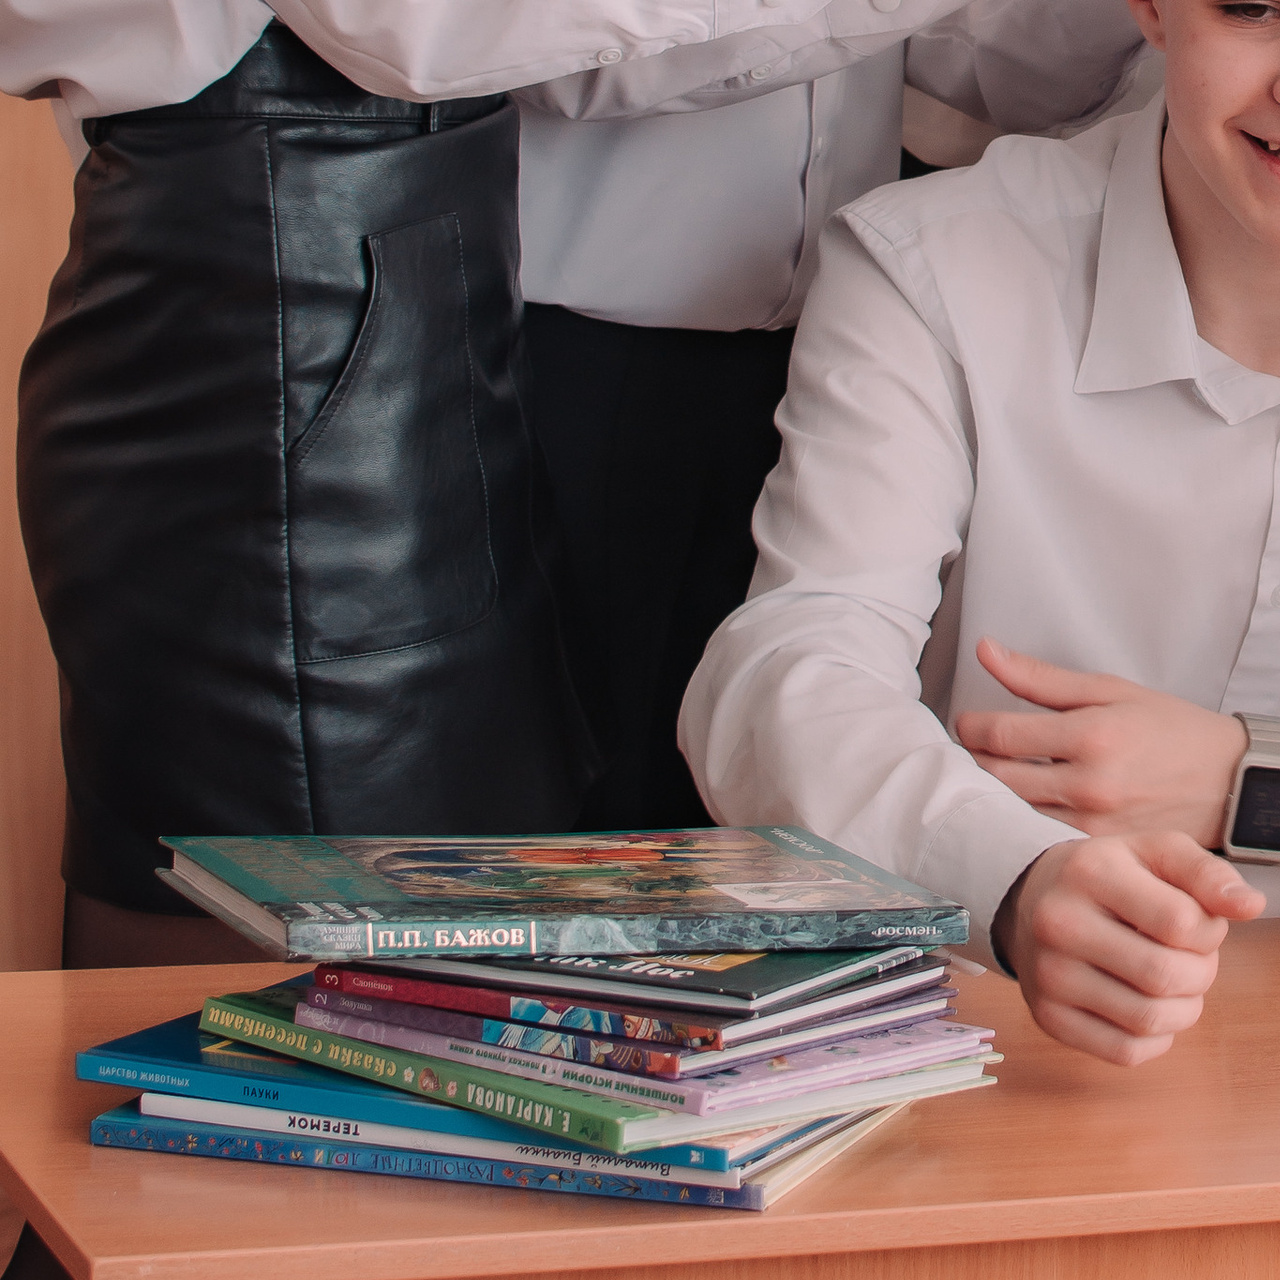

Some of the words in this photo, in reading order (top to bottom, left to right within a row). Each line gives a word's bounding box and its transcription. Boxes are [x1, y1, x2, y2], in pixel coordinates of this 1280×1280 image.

[322, 926, 361, 934] ЛУЧШИЕ
[323, 934, 361, 942] СКАЗКИ
[377, 929, 428, 949] П.П.
[434, 927, 526, 948] БАЖОВ
[871, 926, 943, 937] «РОСМЭН»
[335, 942, 362, 951] МИРА
[325, 974, 339, 986] 3
[352, 977, 394, 992] Слонёнок
[314, 993, 328, 1005] 2
[339, 997, 373, 1012] Золушка
[208, 1007, 308, 1053] песенками
[311, 1038, 323, 1054] с
[99, 1065, 138, 1080] ЦАРСТВО
[139, 1070, 190, 1087] ЖИВОТНЫХ
[562, 1068, 613, 1088] ИСТОРИИ
[243, 1085, 280, 1101] ПАУКИ
[614, 1079, 686, 1106] ВОЛШЕБНЫЕ
[466, 1082, 553, 1127] КАРГАНОВА
[288, 1115, 360, 1136] ТЕРЕМОК
[314, 1148, 359, 1166] ЛЮДИ
[515, 1145, 583, 1166] Бианки
[370, 1153, 495, 1181] РАЗНОЦВЕТНЫЕ
[586, 1153, 671, 1177] Виталий
